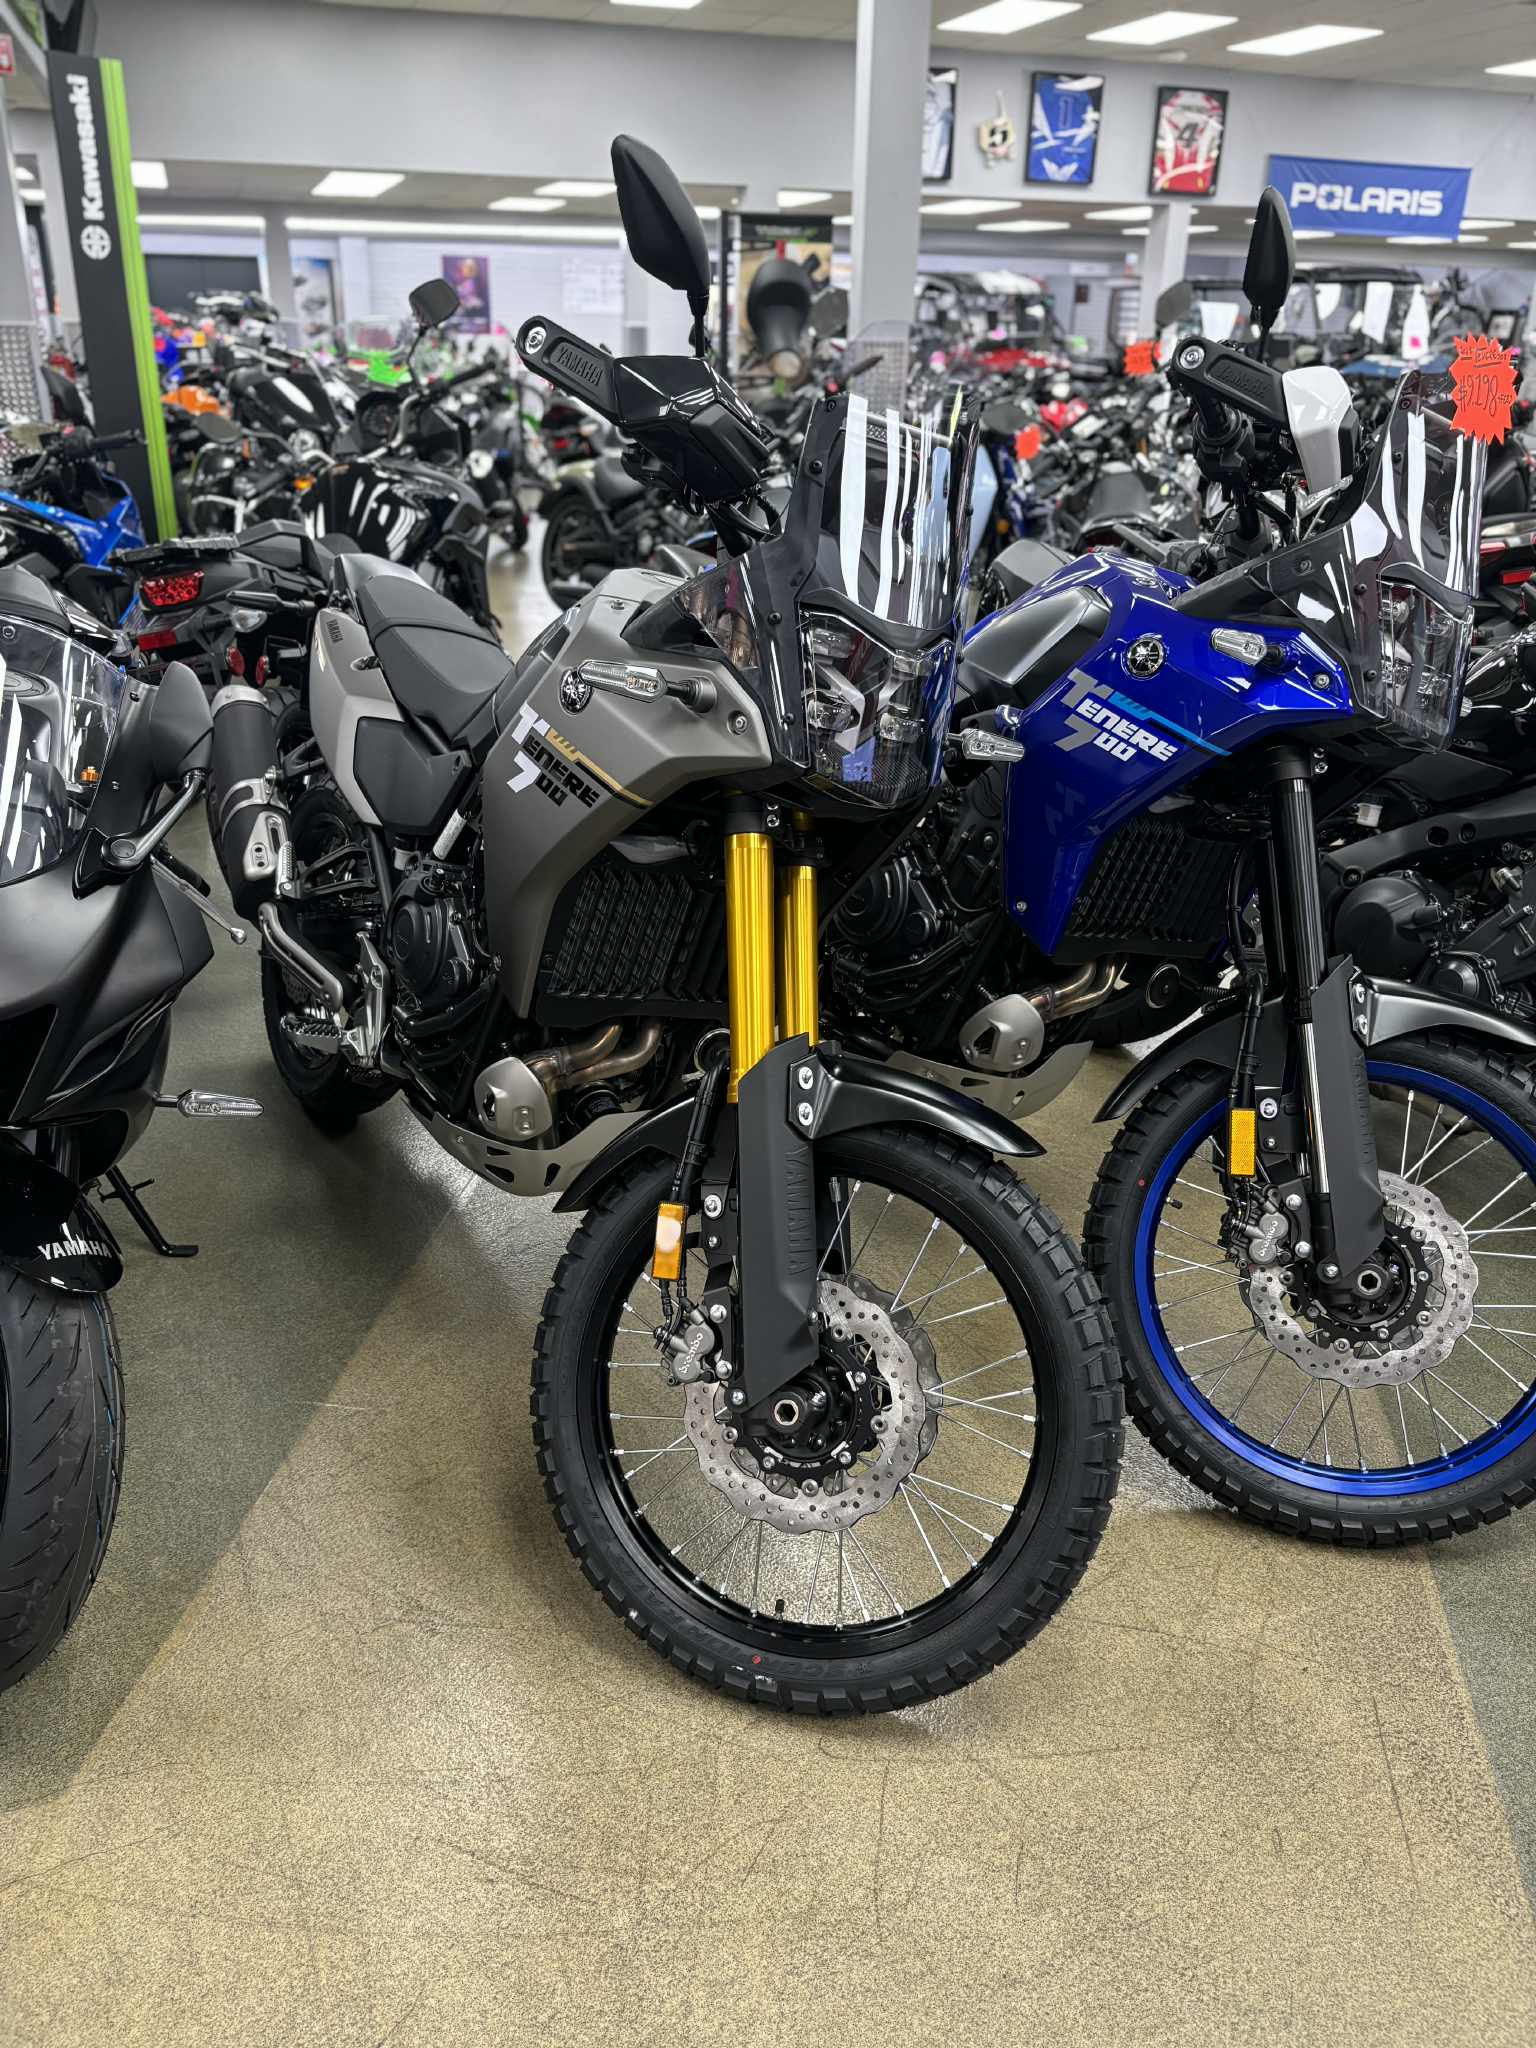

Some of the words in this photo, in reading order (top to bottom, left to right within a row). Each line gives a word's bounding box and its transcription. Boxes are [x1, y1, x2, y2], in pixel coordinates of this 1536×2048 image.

[66, 73, 105, 221] Kawasaki
[1177, 122, 1200, 148] 4
[1289, 181, 1443, 217] POLARIS
[557, 346, 604, 387] YAMAHA
[326, 618, 344, 644] YAMAHA
[1060, 667, 1179, 762] TENERE
[511, 702, 601, 808] TENERE
[1053, 713, 1137, 762] 700
[506, 750, 568, 807] 700
[36, 1240, 113, 1261] YAMAHA
